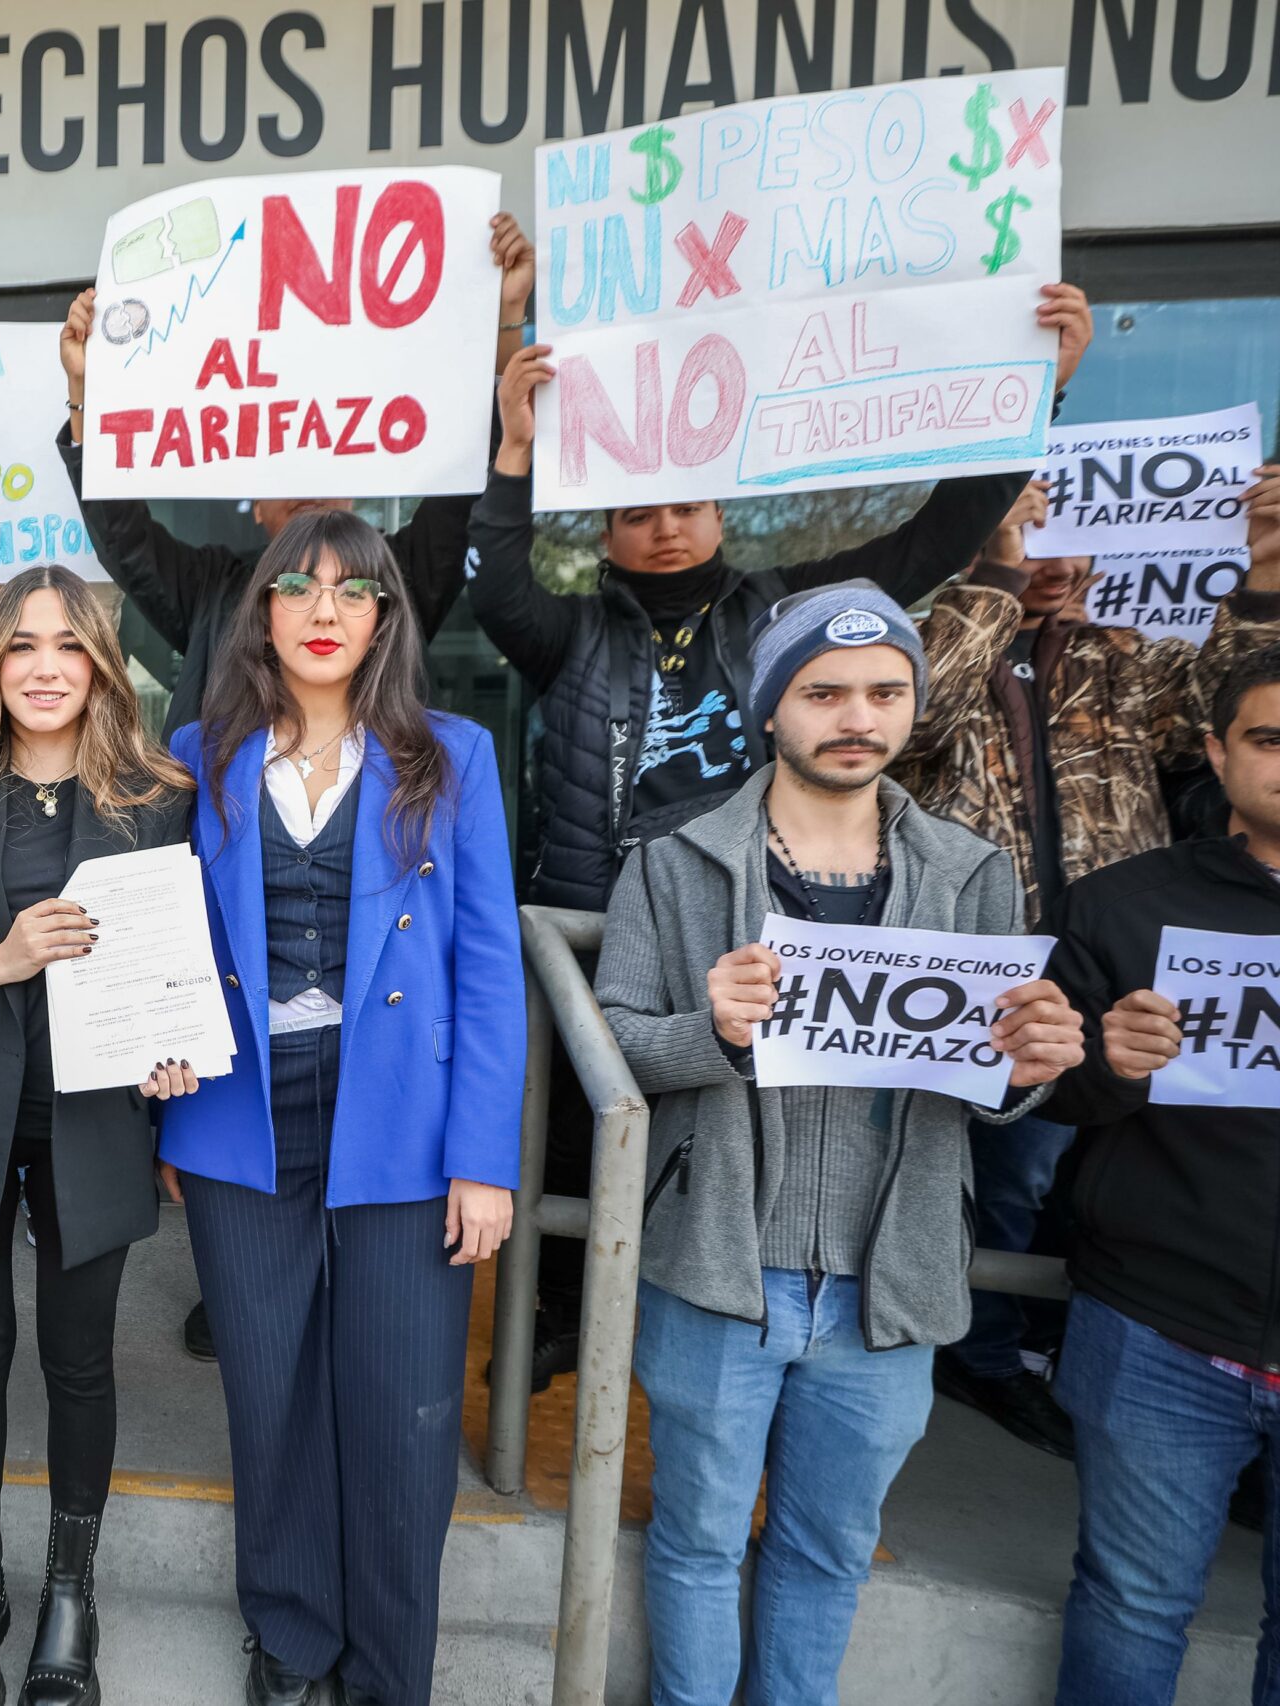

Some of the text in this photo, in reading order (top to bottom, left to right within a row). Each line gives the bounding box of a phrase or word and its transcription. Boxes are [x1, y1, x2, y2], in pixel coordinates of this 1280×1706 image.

[1065, 0, 1280, 106] NU
[547, 141, 611, 209] NI
[698, 88, 926, 202] PESO
[258, 179, 446, 332] NO
[549, 206, 663, 327] UN
[769, 177, 958, 291] MAS
[194, 337, 279, 390] AL
[558, 301, 899, 488] NO AL
[99, 394, 428, 469] TARIFAZO
[758, 373, 1030, 457] TARIFAZO
[1069, 435, 1154, 454] JOVENES
[1158, 426, 1252, 448] DECIMOS
[1204, 466, 1247, 487] AL
[1072, 497, 1243, 528] TARIFAZO
[1130, 606, 1217, 627] TARIF
[767, 940, 1037, 979] LOS JOVENES DECIMOS
[1166, 954, 1223, 976] LOS
[761, 967, 968, 1040] #NO
[802, 1025, 1005, 1068] TARIFAZO
